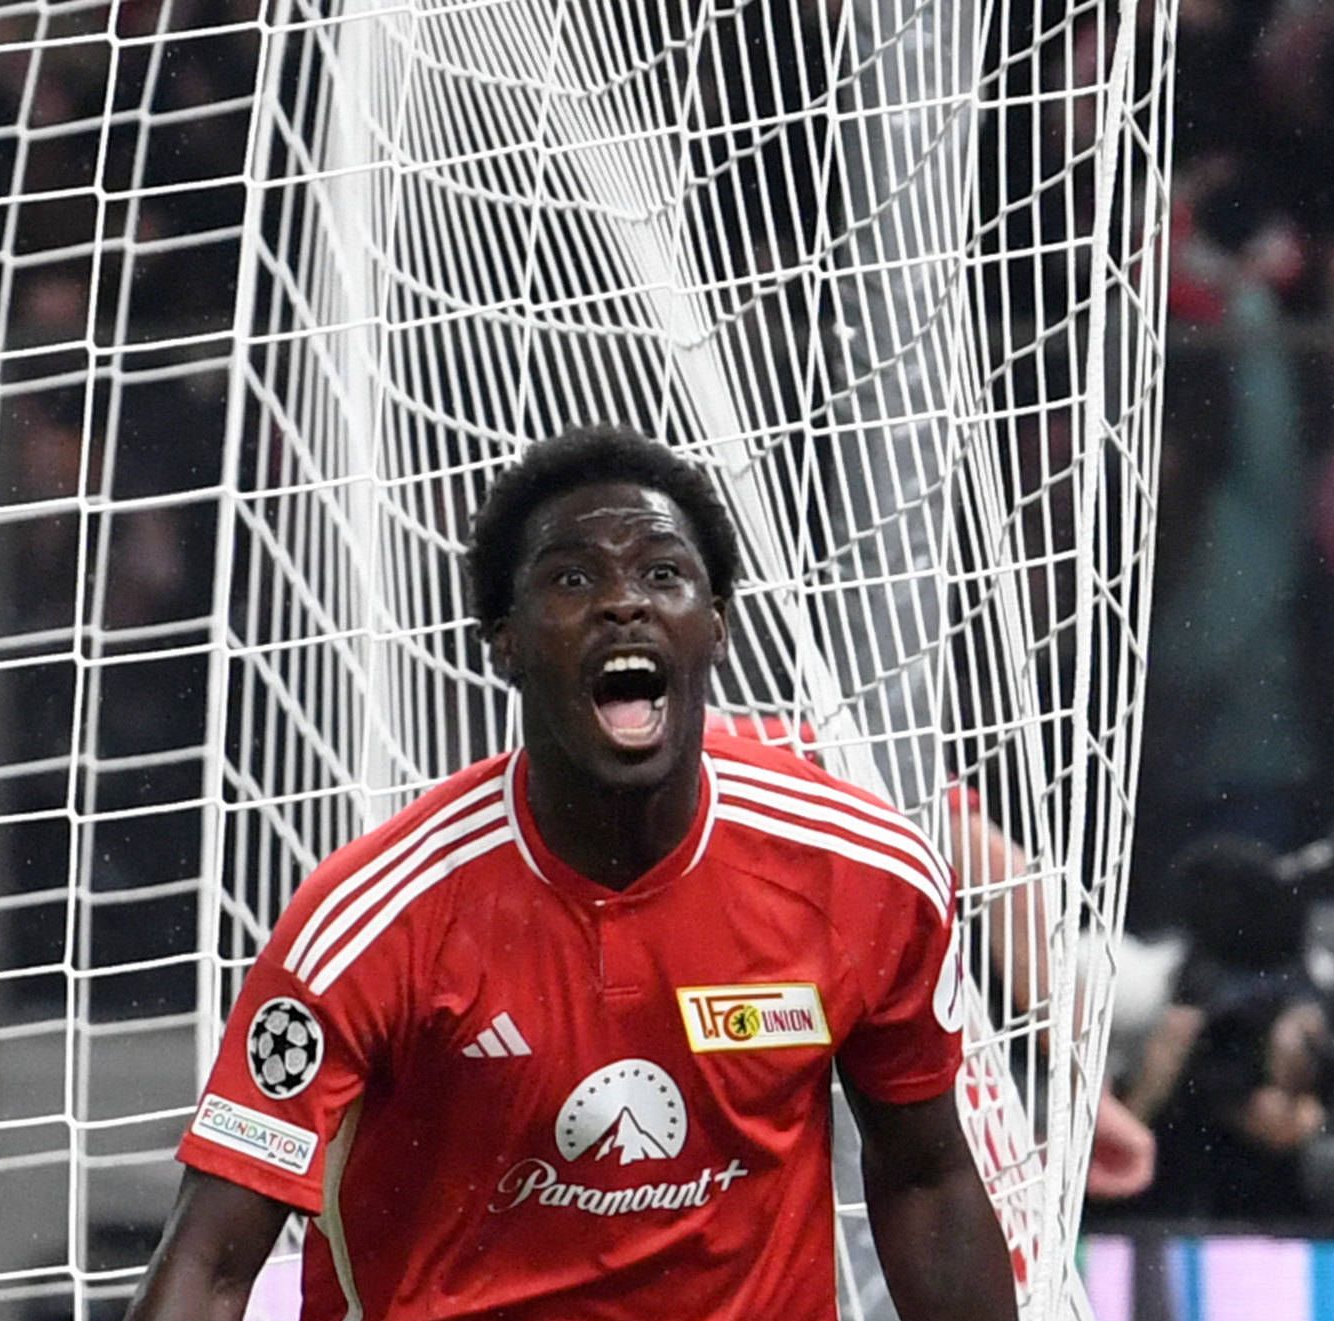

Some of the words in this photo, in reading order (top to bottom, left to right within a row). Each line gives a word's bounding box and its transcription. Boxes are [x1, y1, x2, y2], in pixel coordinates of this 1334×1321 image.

[762, 1009, 814, 1033] UNION
[200, 1109, 310, 1160] FOUNDATION
[487, 1158, 748, 1216] Paramount+
